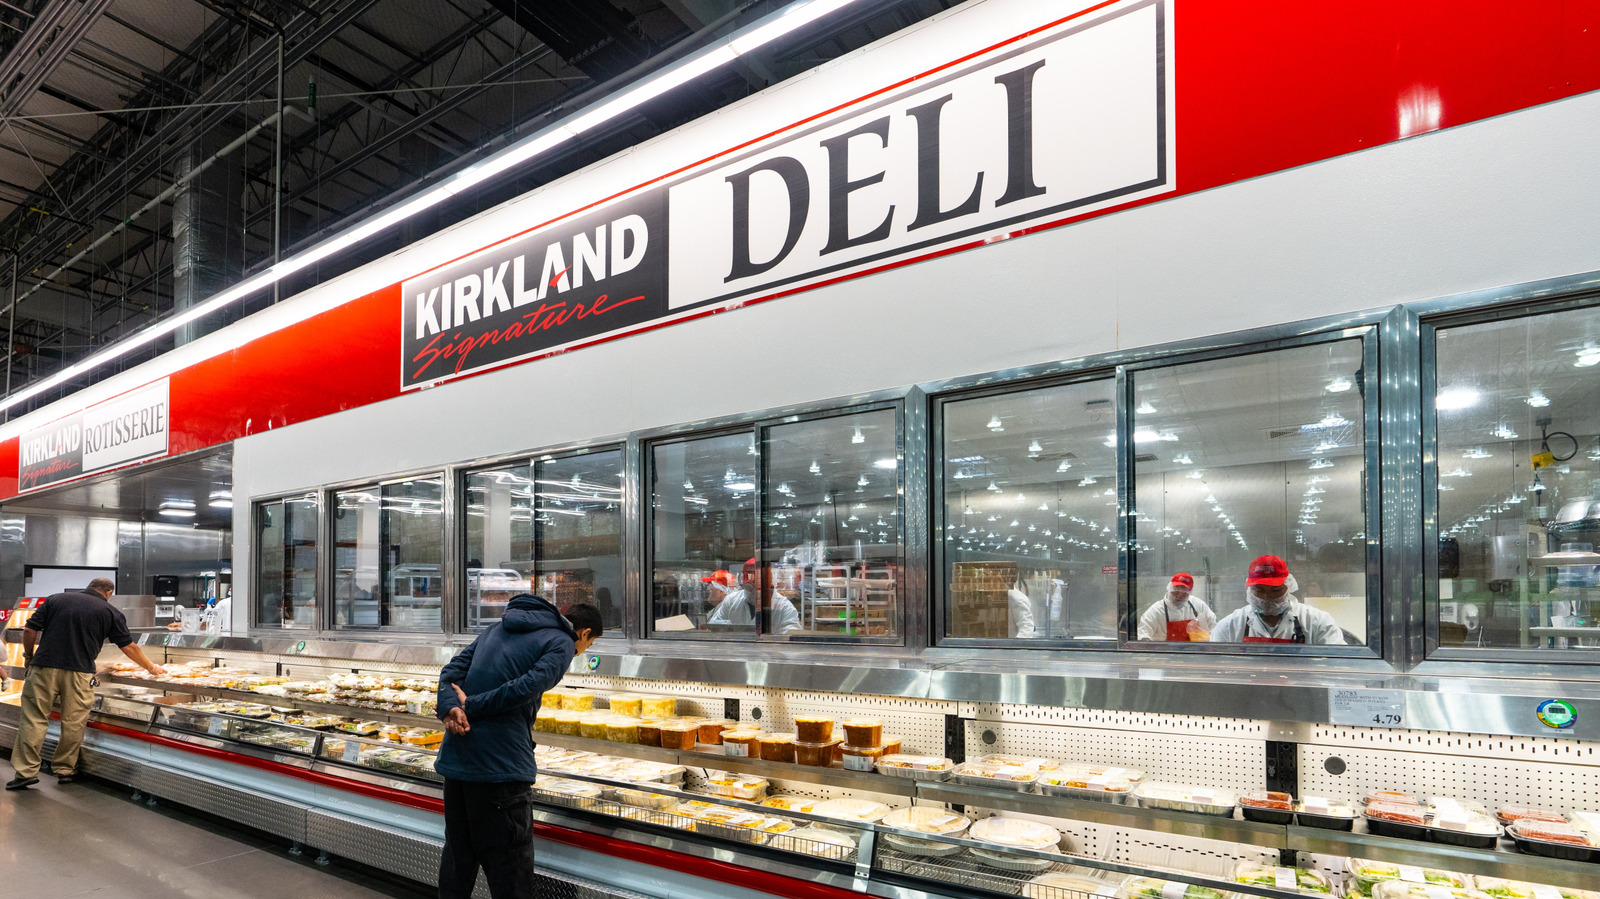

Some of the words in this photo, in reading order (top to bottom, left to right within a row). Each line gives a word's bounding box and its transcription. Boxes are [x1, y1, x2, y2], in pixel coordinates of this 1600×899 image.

[724, 58, 1047, 284] DELI
[415, 214, 649, 340] KIRKLAND
[412, 294, 645, 375] Signature
[22, 423, 81, 467] KIRKLAND
[84, 402, 165, 455] ROTISSERIE
[21, 459, 79, 488] Signature
[1373, 714, 1402, 724] 4.79
